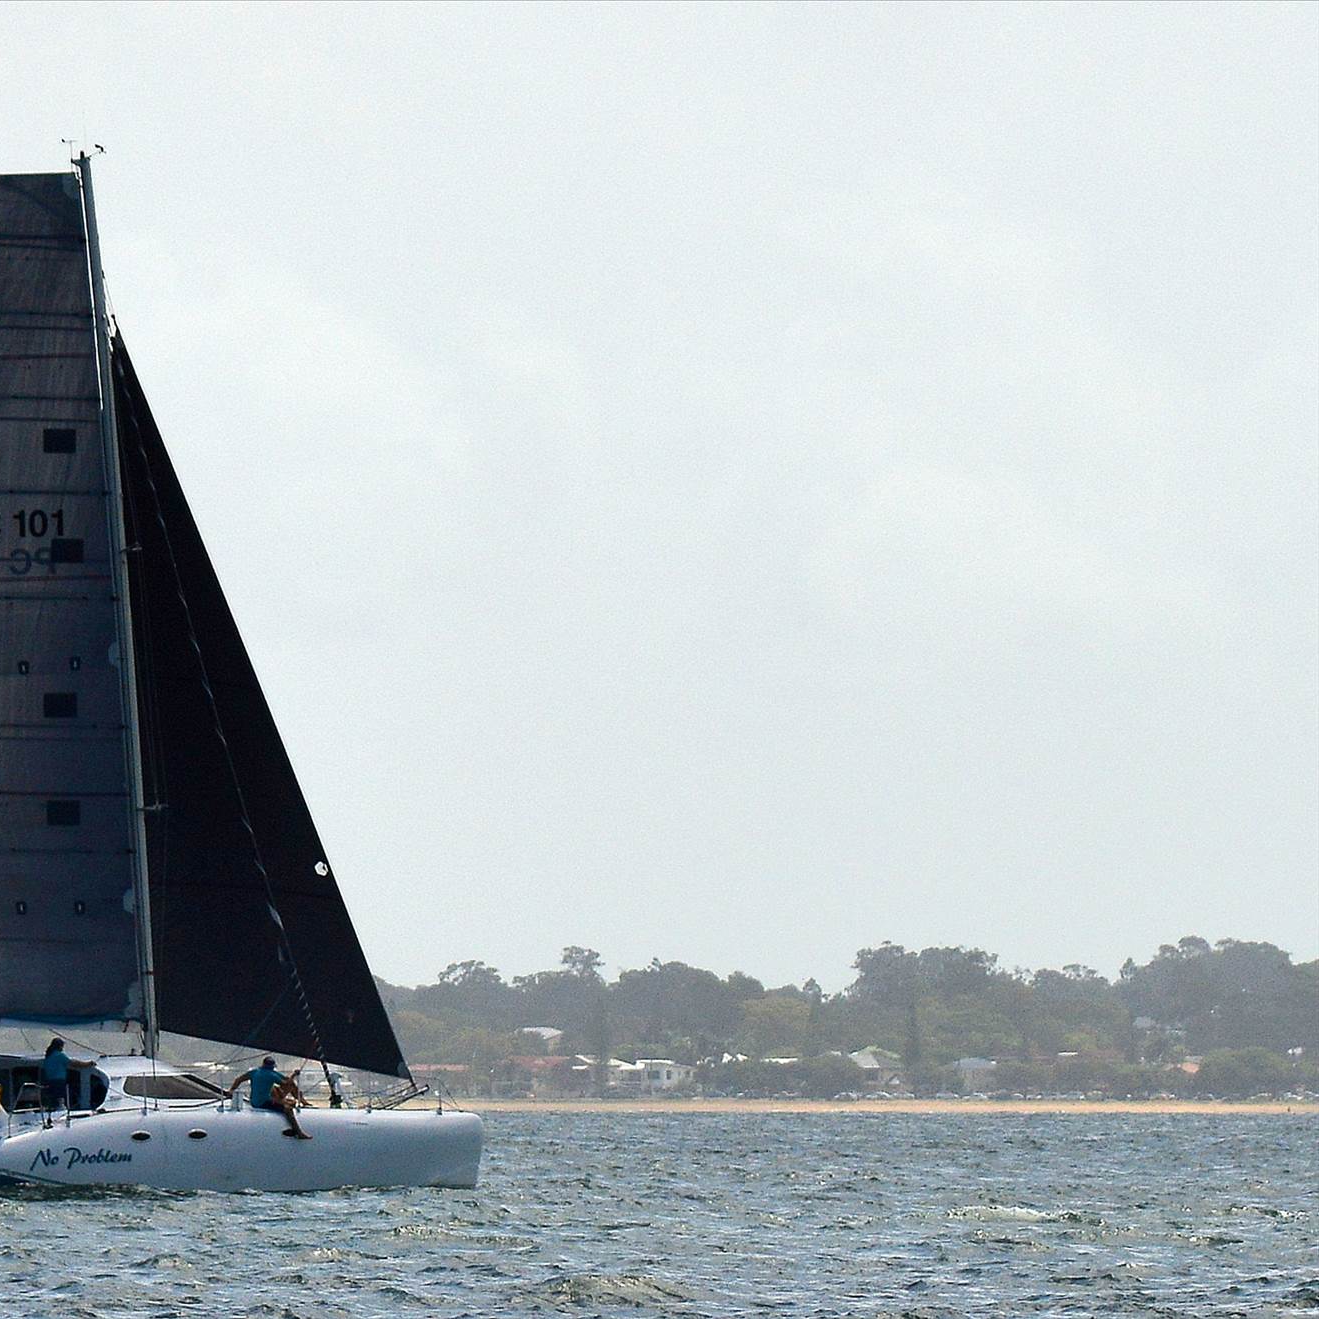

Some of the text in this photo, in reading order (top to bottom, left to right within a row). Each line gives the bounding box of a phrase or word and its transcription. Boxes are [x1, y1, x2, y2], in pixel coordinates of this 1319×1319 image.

[13, 509, 65, 537] 101
[30, 1147, 132, 1171] No Problem
